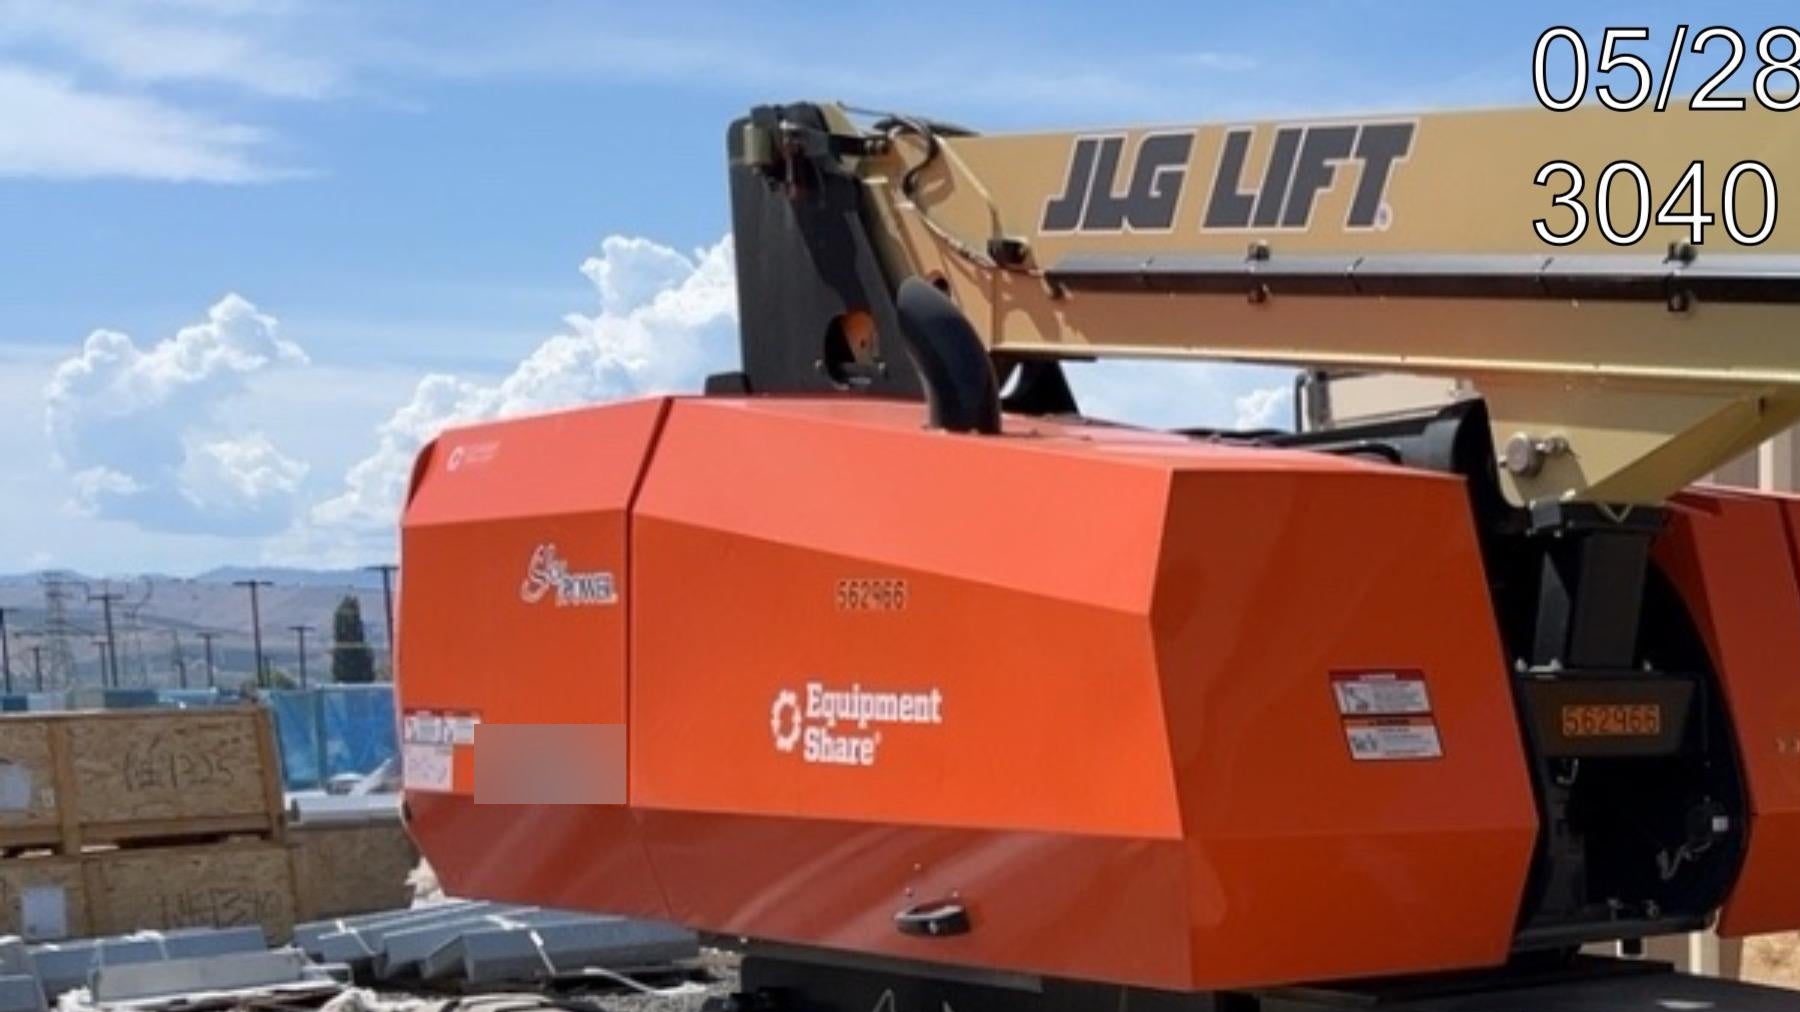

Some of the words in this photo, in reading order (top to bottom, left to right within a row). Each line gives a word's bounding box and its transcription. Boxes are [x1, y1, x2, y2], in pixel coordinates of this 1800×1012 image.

[1040, 130, 1197, 234] JLG
[1201, 118, 1418, 233] LIFT
[805, 682, 943, 730] Equipment
[802, 726, 875, 766] Share
